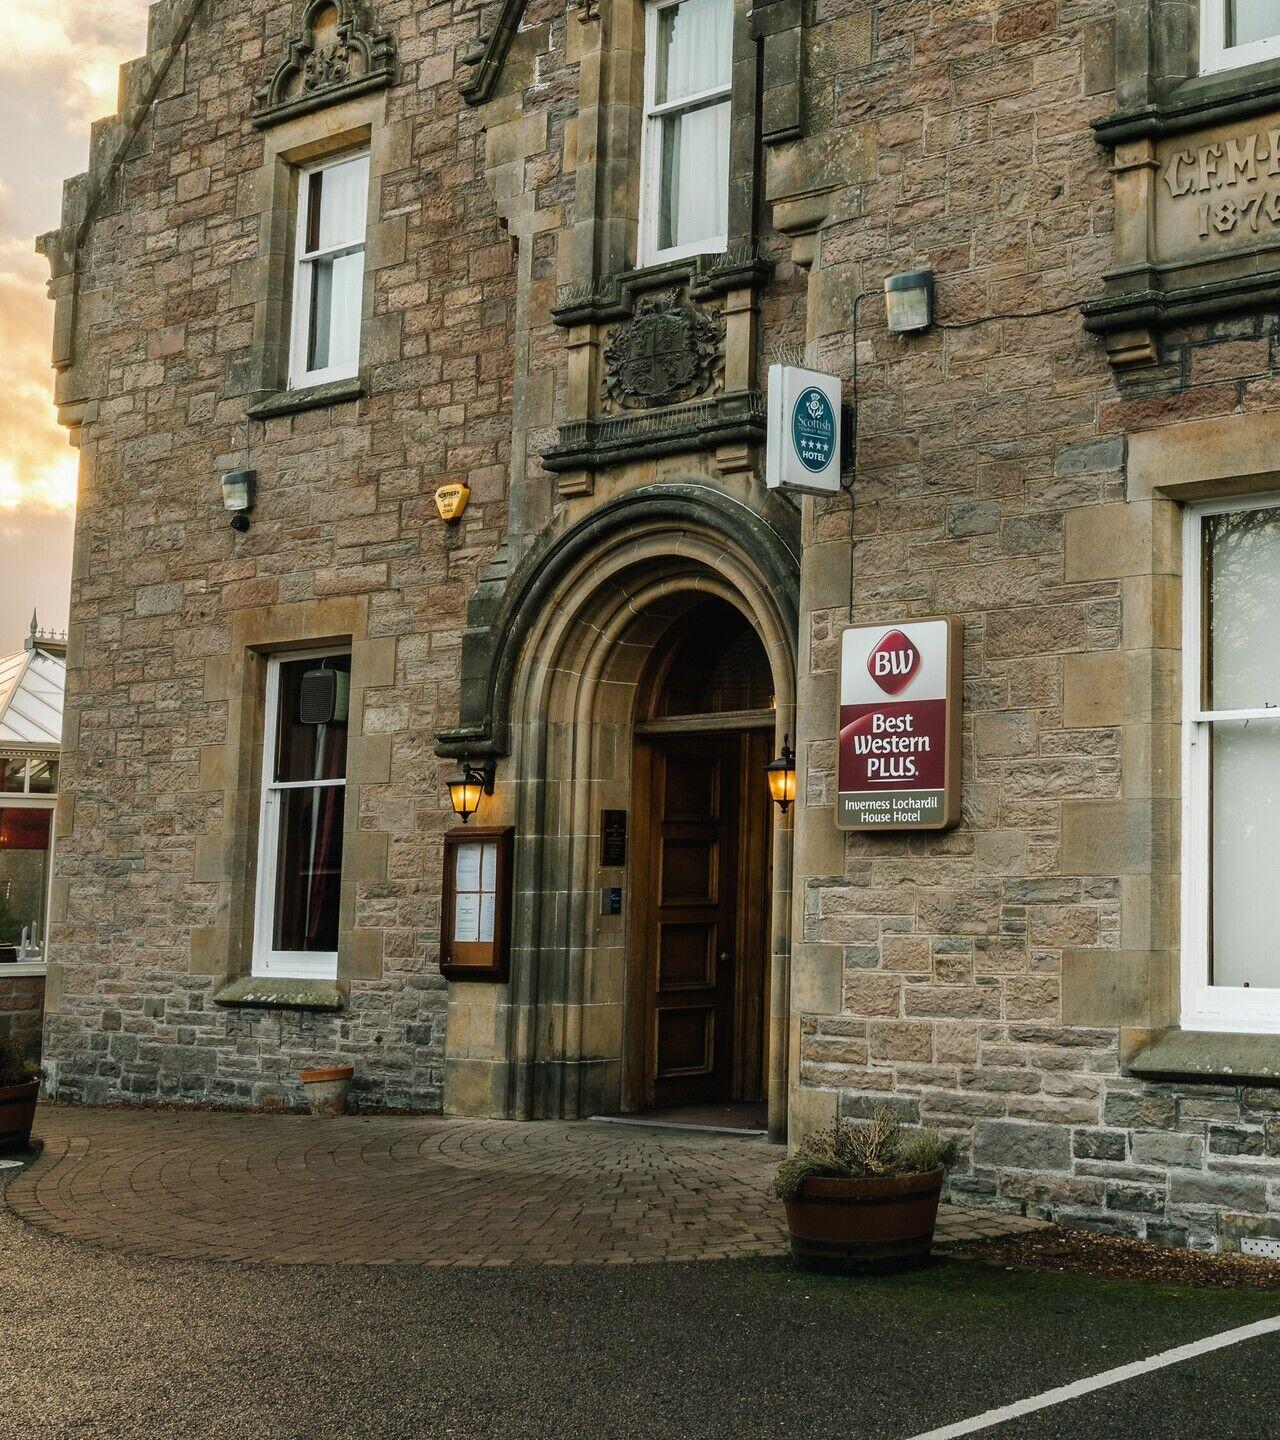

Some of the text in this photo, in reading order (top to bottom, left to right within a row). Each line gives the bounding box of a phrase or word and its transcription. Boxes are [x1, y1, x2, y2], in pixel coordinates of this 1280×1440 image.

[798, 414, 831, 431] Scottish
[802, 450, 826, 461] HOTEL
[875, 649, 913, 676] BW
[872, 713, 913, 734] Best
[854, 735, 930, 755] Western
[845, 796, 938, 811] Inverness Lochardil
[860, 810, 920, 823] House Hotel
